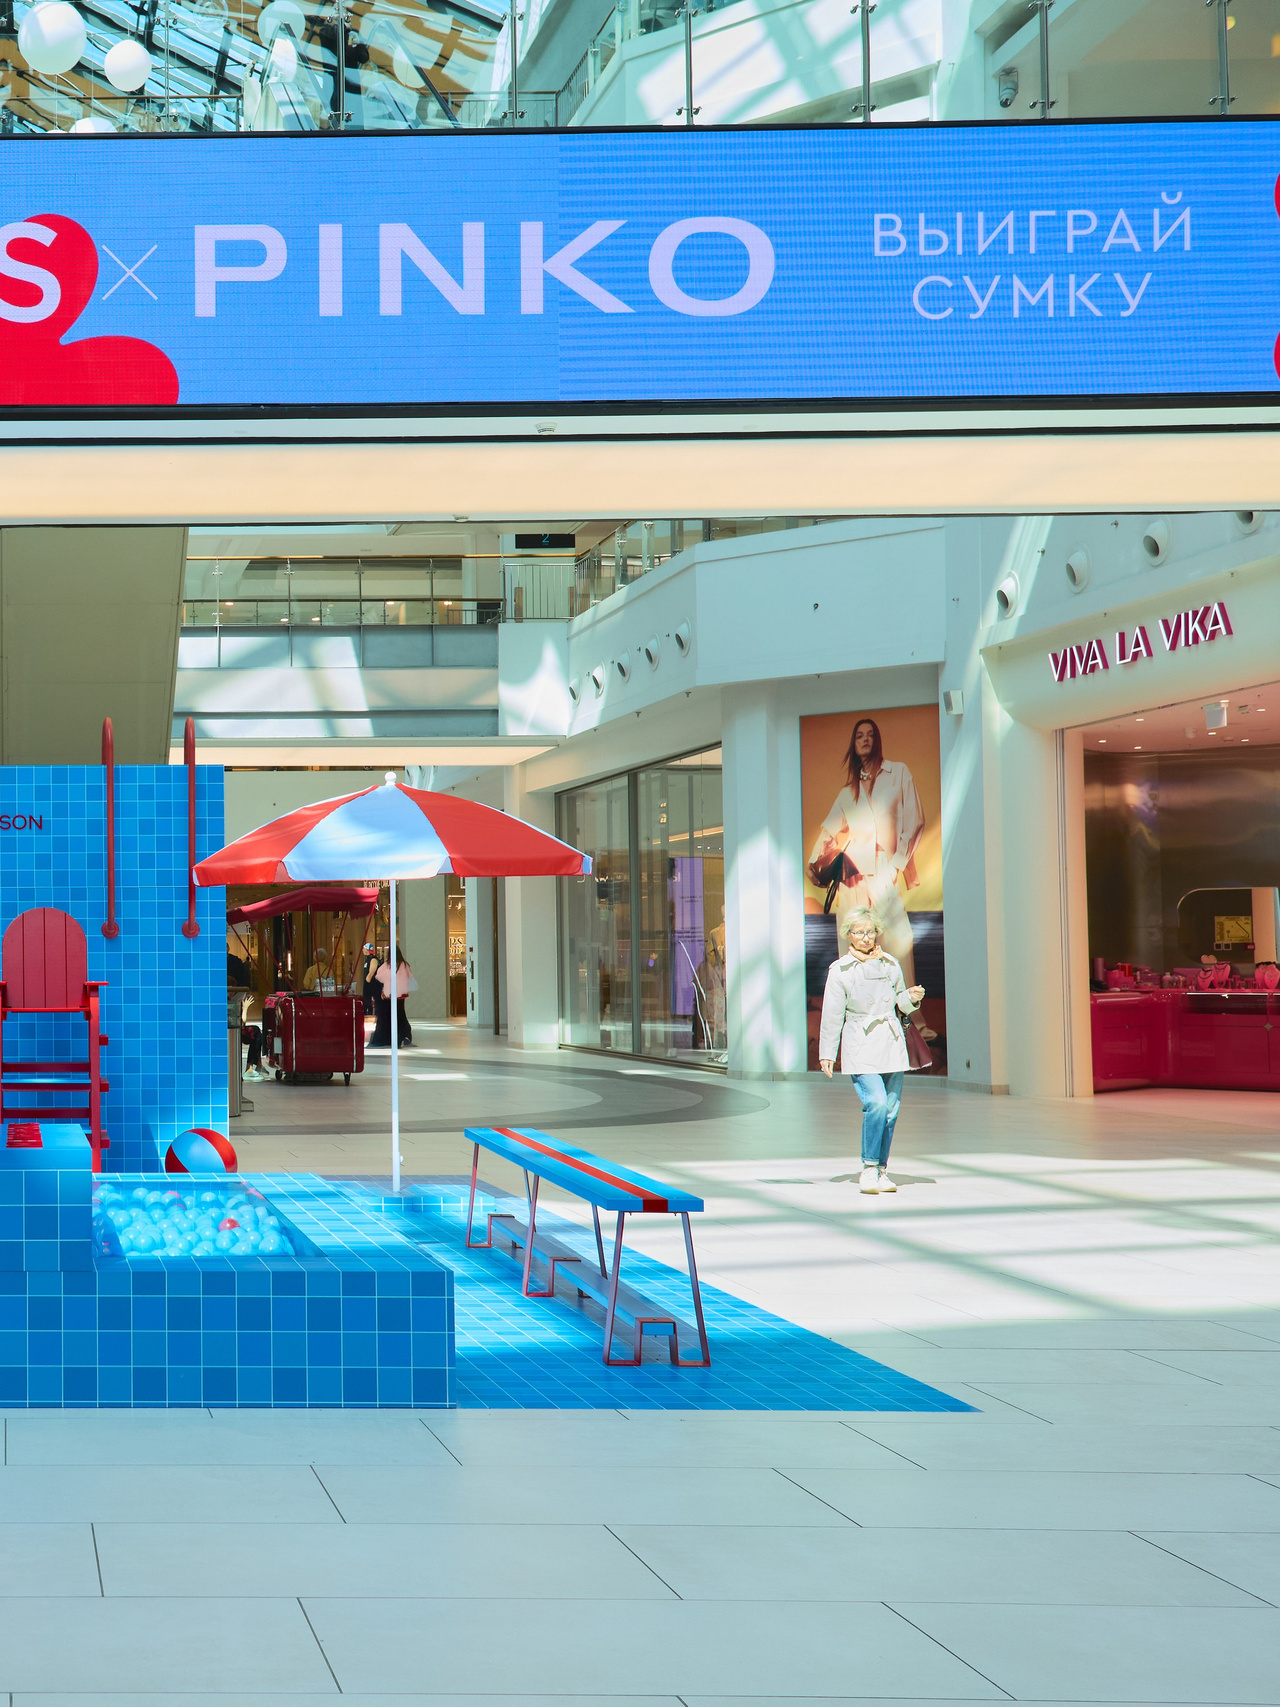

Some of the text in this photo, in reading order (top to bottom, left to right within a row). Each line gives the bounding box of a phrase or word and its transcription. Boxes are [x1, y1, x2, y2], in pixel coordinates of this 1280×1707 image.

[873, 191, 1191, 257] ВЫИГРАЙ
[194, 215, 776, 318] PINKO
[912, 272, 1153, 320] СУМКУ
[1047, 602, 1234, 682] VIVA LA VIKA
